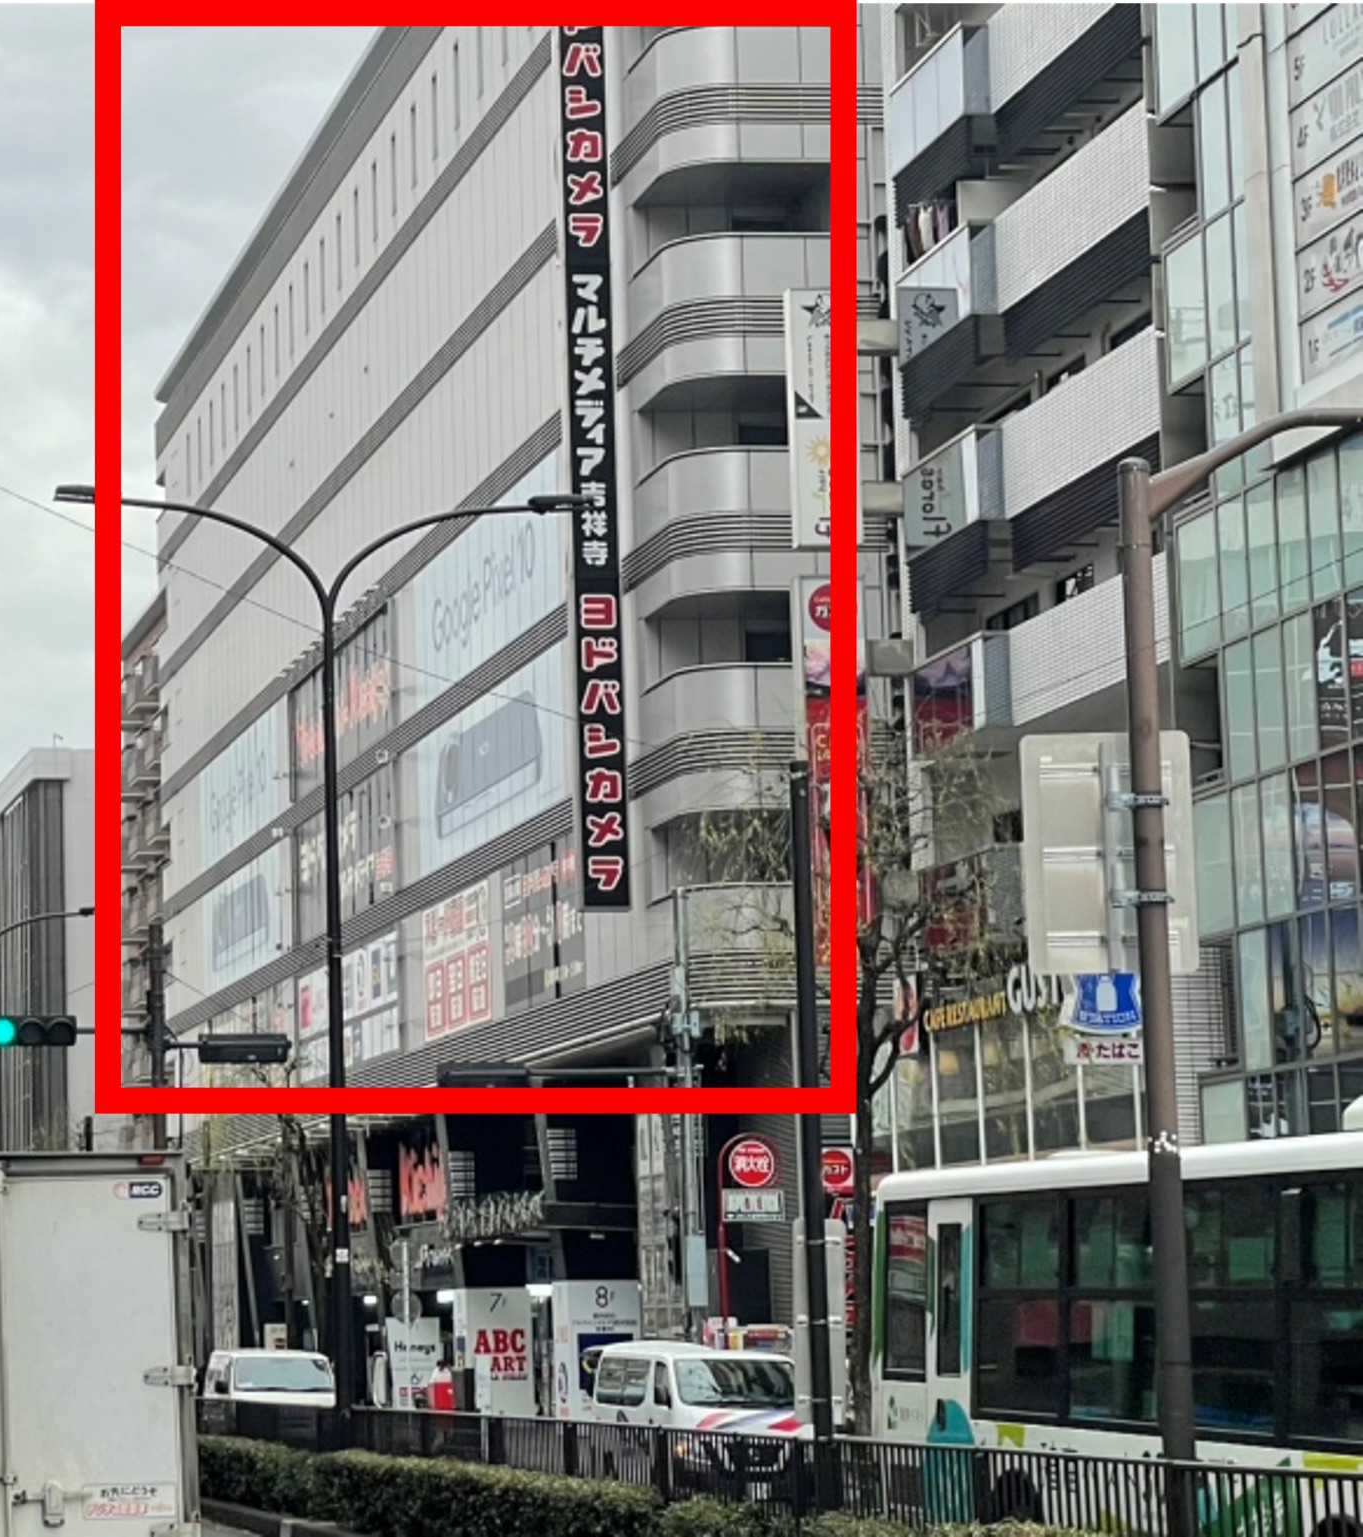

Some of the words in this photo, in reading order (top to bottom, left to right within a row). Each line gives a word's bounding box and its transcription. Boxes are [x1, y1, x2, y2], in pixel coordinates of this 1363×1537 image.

[563, 26, 604, 247] バシカメラ
[571, 273, 608, 566] マルチメディア吉祥寺
[432, 570, 481, 652] Google
[483, 532, 515, 614] Pixel
[518, 519, 535, 584] 10
[580, 593, 624, 890] ヨドバシカメラ
[474, 1328, 526, 1355] ABC
[490, 1356, 527, 1372] ART
